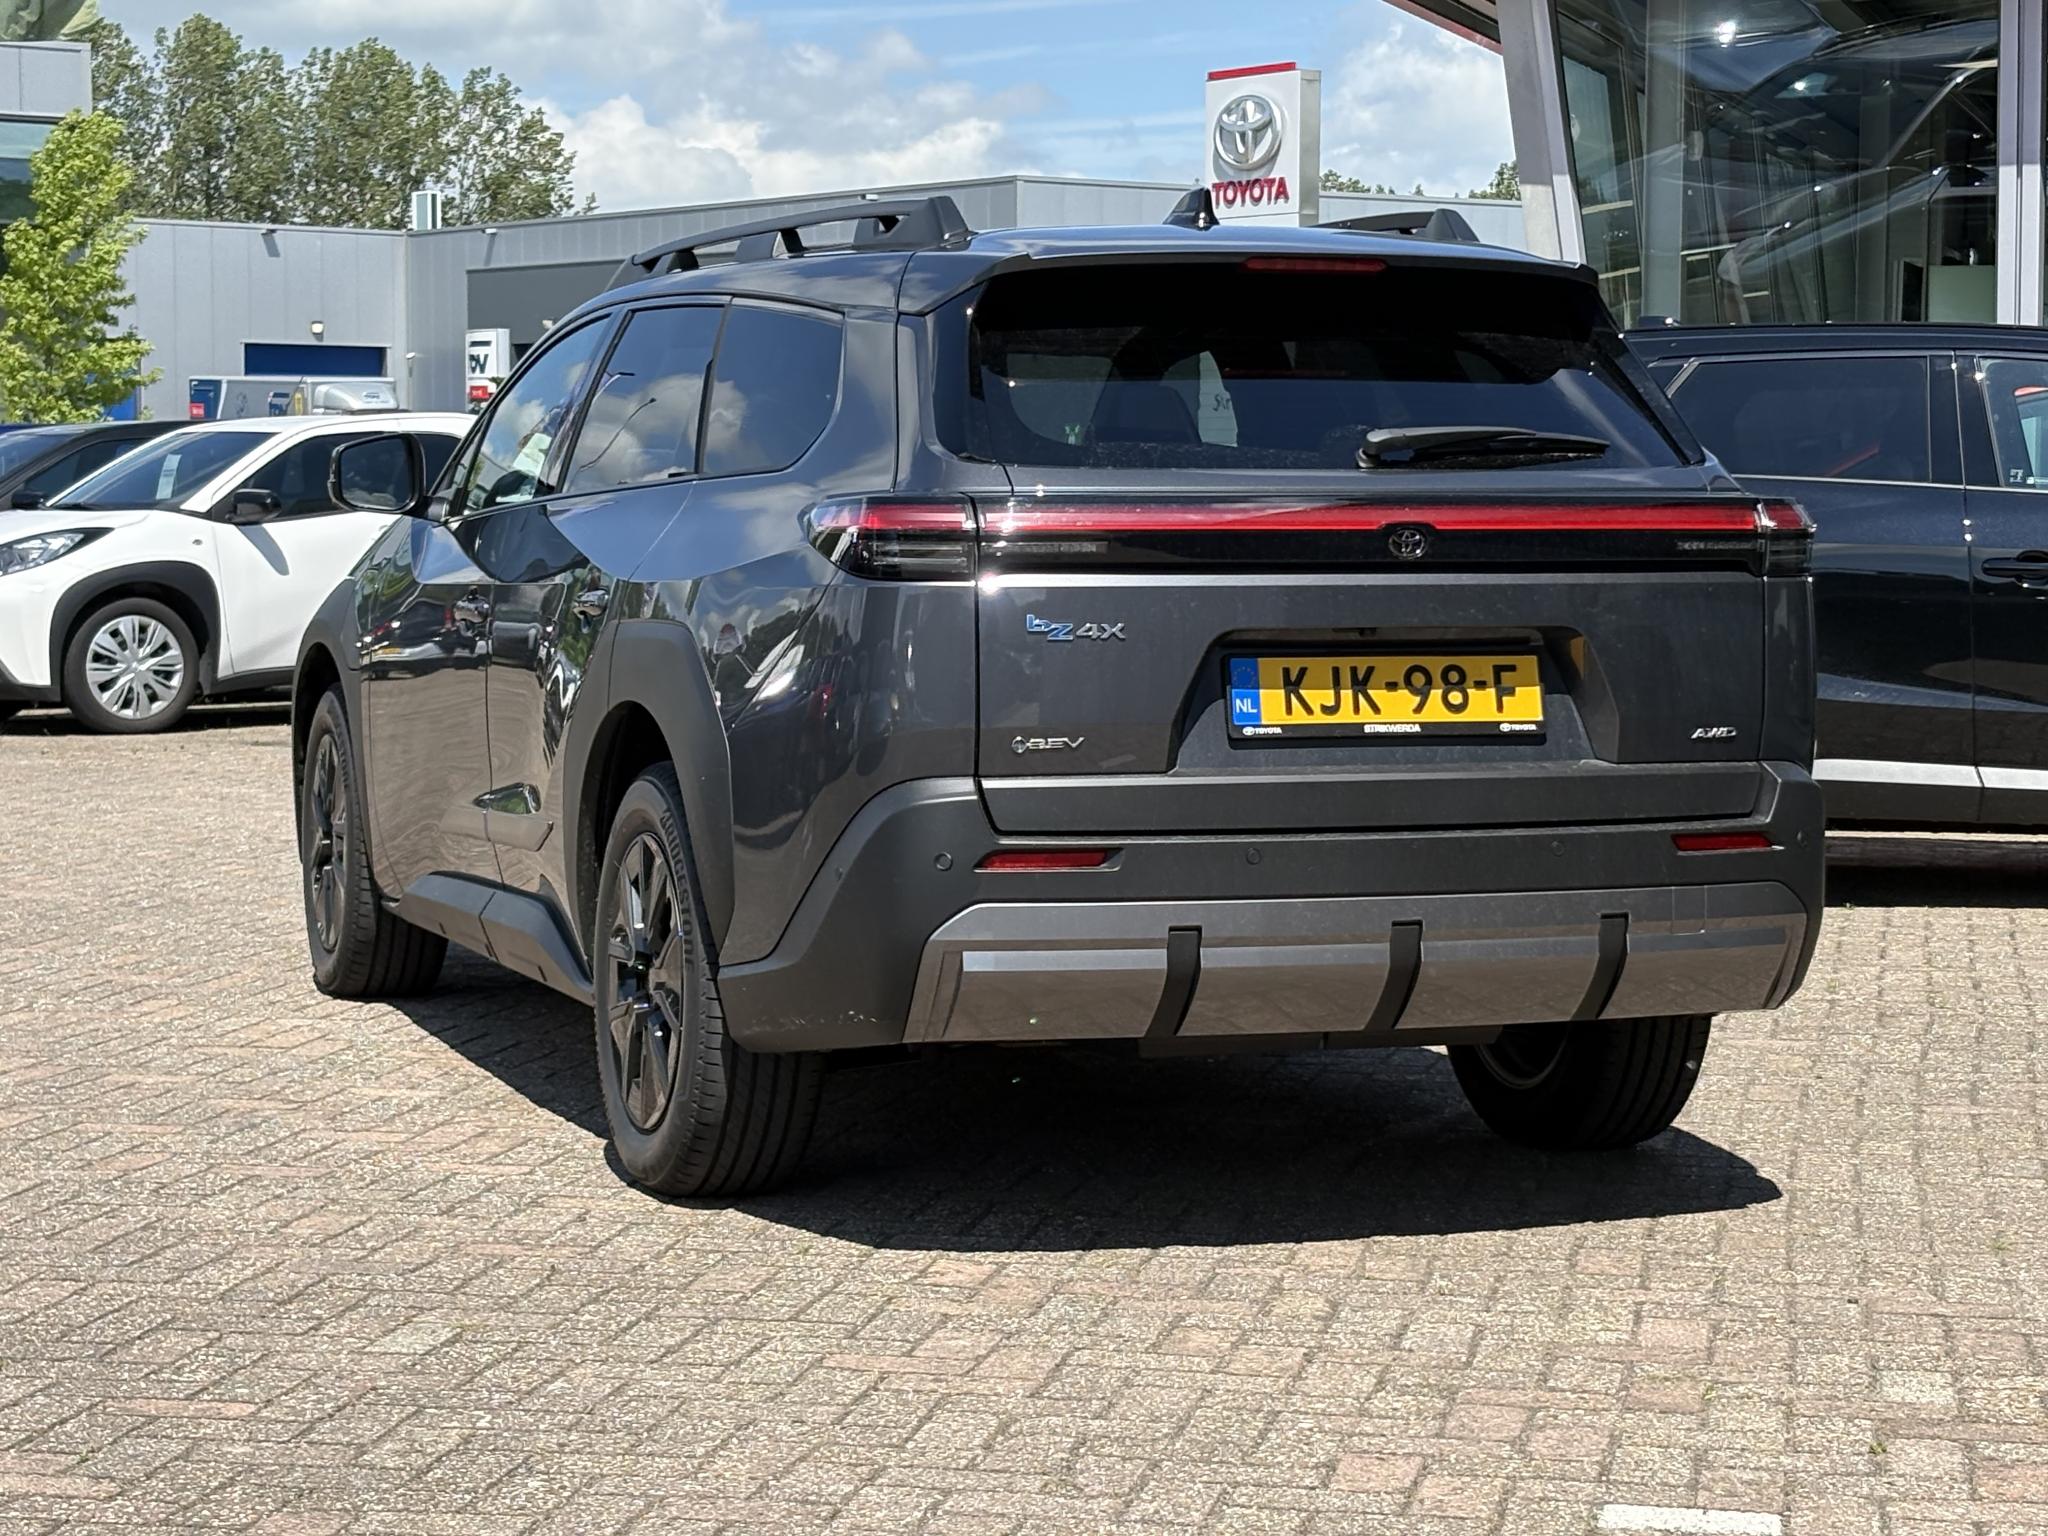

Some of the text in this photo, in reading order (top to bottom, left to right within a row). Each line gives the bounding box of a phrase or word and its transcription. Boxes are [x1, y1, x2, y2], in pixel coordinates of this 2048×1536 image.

[1211, 176, 1290, 209] TOYOTA
[1281, 663, 1518, 717] KJK-98-F
[1235, 698, 1258, 713] NL
[1254, 727, 1282, 735] TOYOTA
[1690, 726, 1737, 739] AWD
